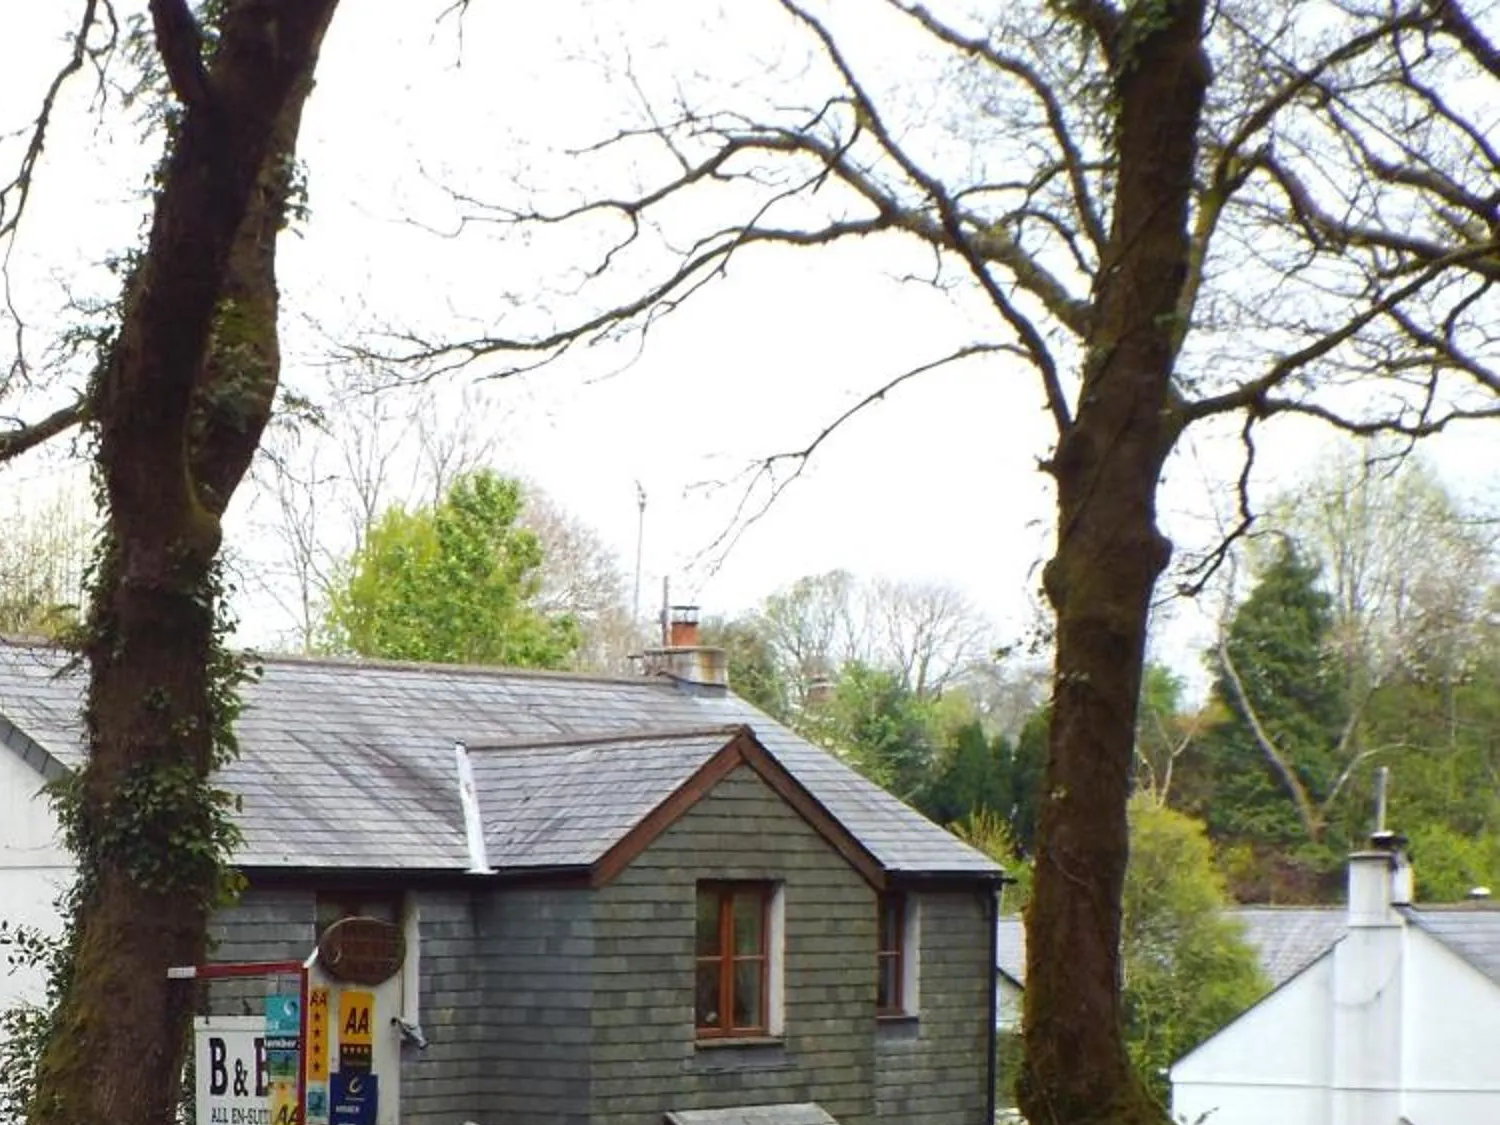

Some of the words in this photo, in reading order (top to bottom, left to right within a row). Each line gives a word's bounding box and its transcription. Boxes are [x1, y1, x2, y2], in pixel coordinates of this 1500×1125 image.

[309, 991, 327, 1007] AA
[344, 1007, 369, 1034] AA
[209, 1037, 228, 1095] B
[234, 1058, 248, 1096] &
